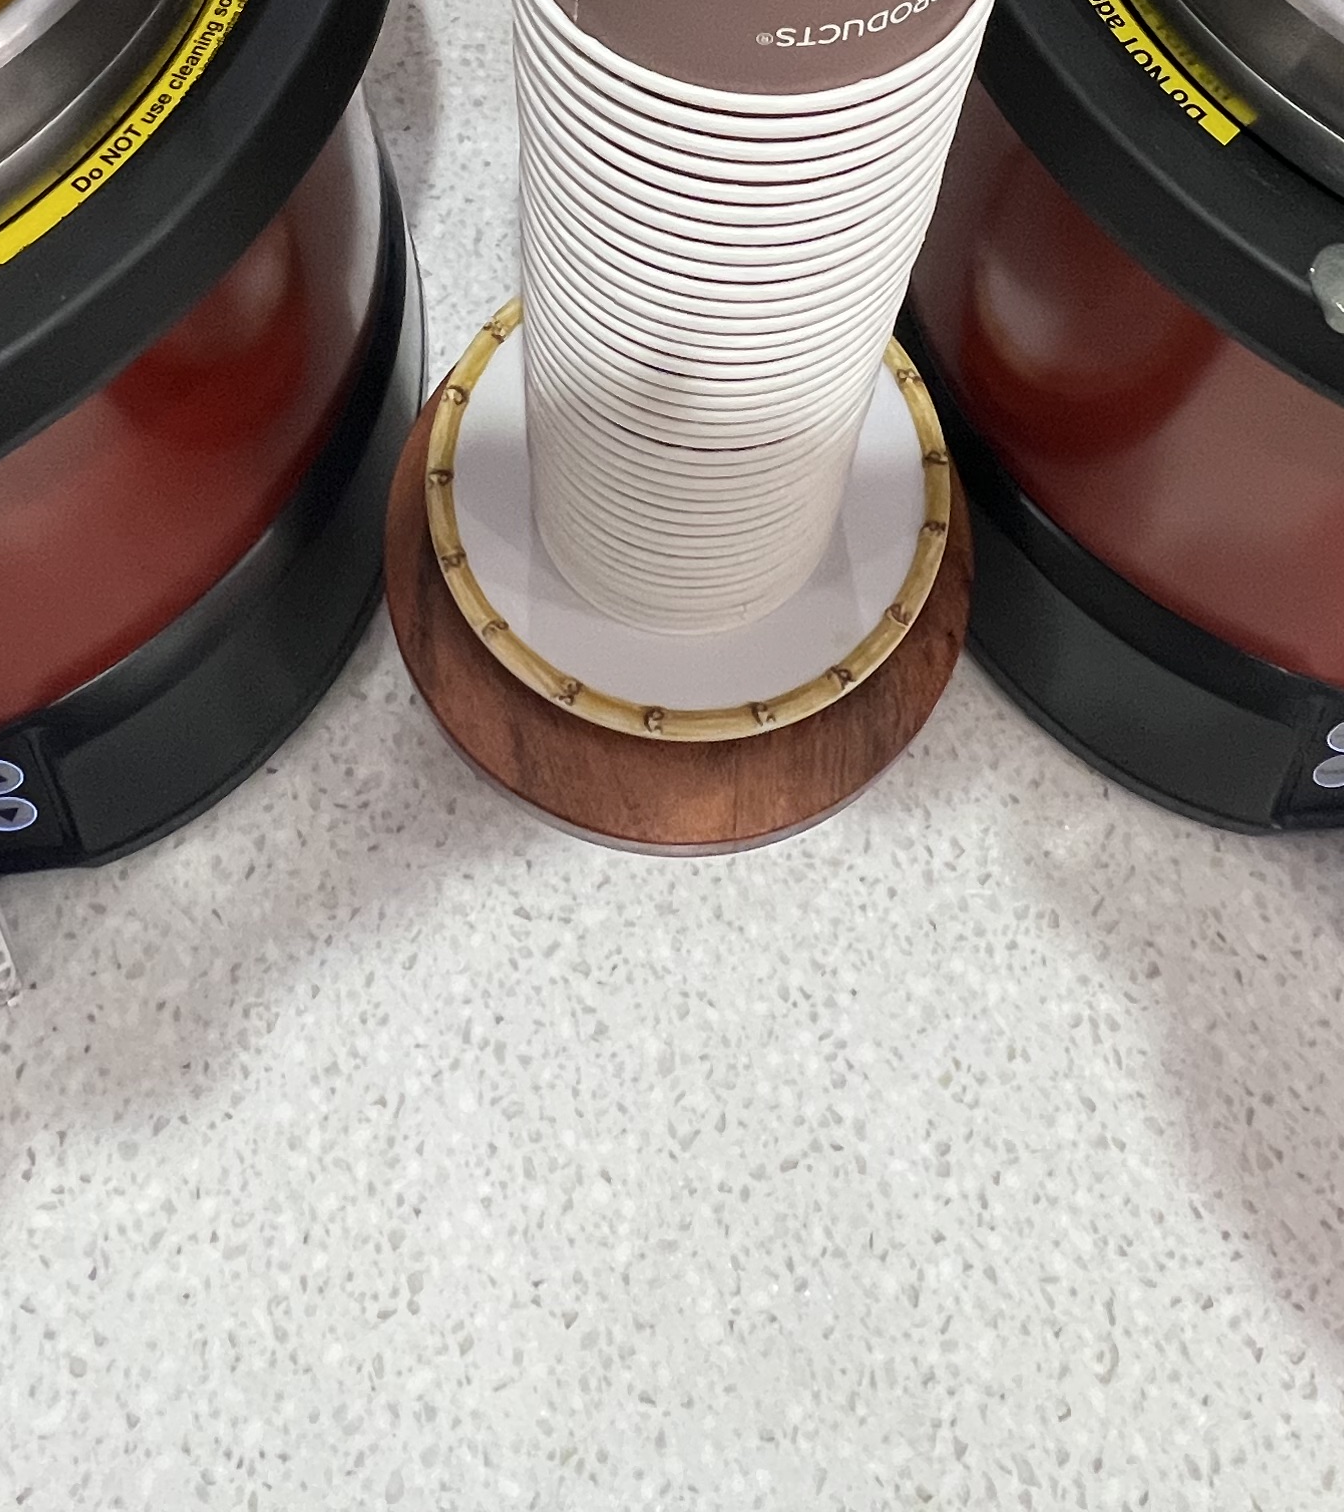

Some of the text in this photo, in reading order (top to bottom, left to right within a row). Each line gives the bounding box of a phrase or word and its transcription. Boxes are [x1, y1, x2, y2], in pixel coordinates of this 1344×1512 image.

[71, 167, 104, 193] Do
[99, 123, 143, 166] NOT
[140, 93, 173, 125] use
[169, 20, 225, 90] cleaning
